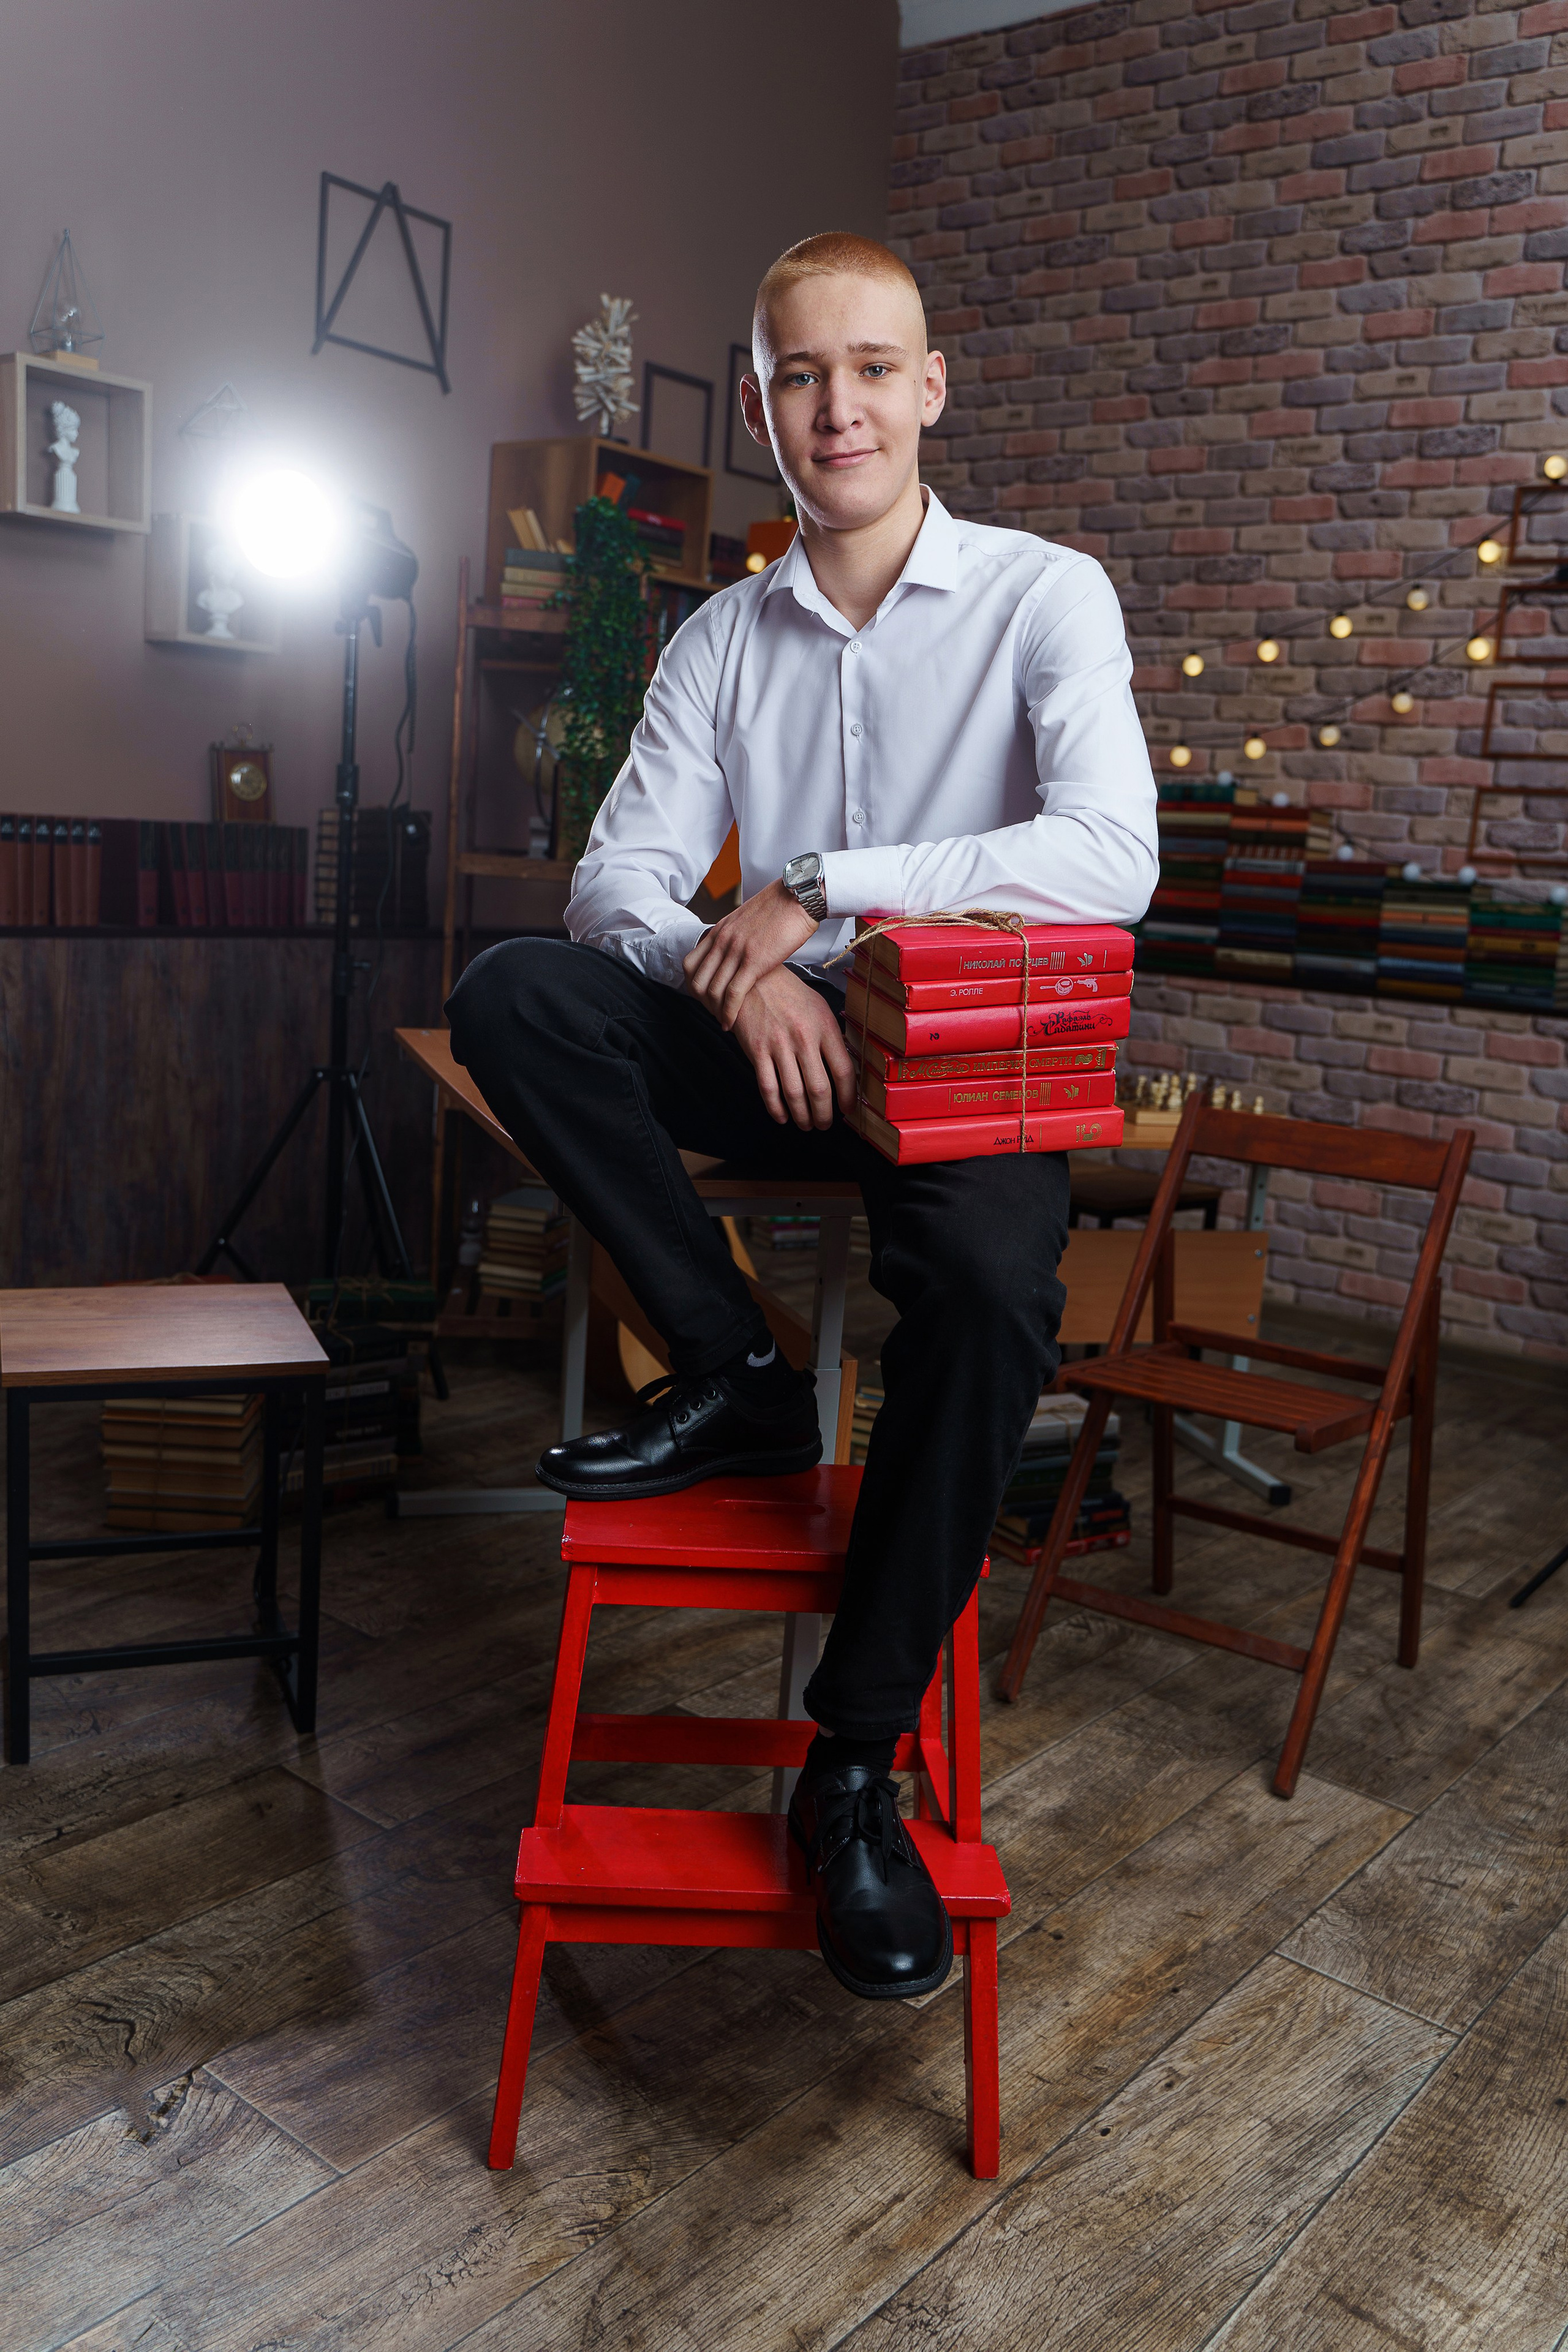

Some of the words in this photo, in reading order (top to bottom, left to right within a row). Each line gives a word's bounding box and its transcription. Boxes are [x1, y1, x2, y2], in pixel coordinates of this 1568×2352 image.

[963, 958, 1006, 969] НИКОЛАЙ
[1049, 1011, 1091, 1024] Рафаэль
[1042, 1021, 1095, 1036] Сабатини
[973, 1060, 1025, 1071] ИМПЕРИЯ
[1029, 1056, 1072, 1068] СМЕРТИ
[954, 1091, 989, 1102] ЮЛИАН
